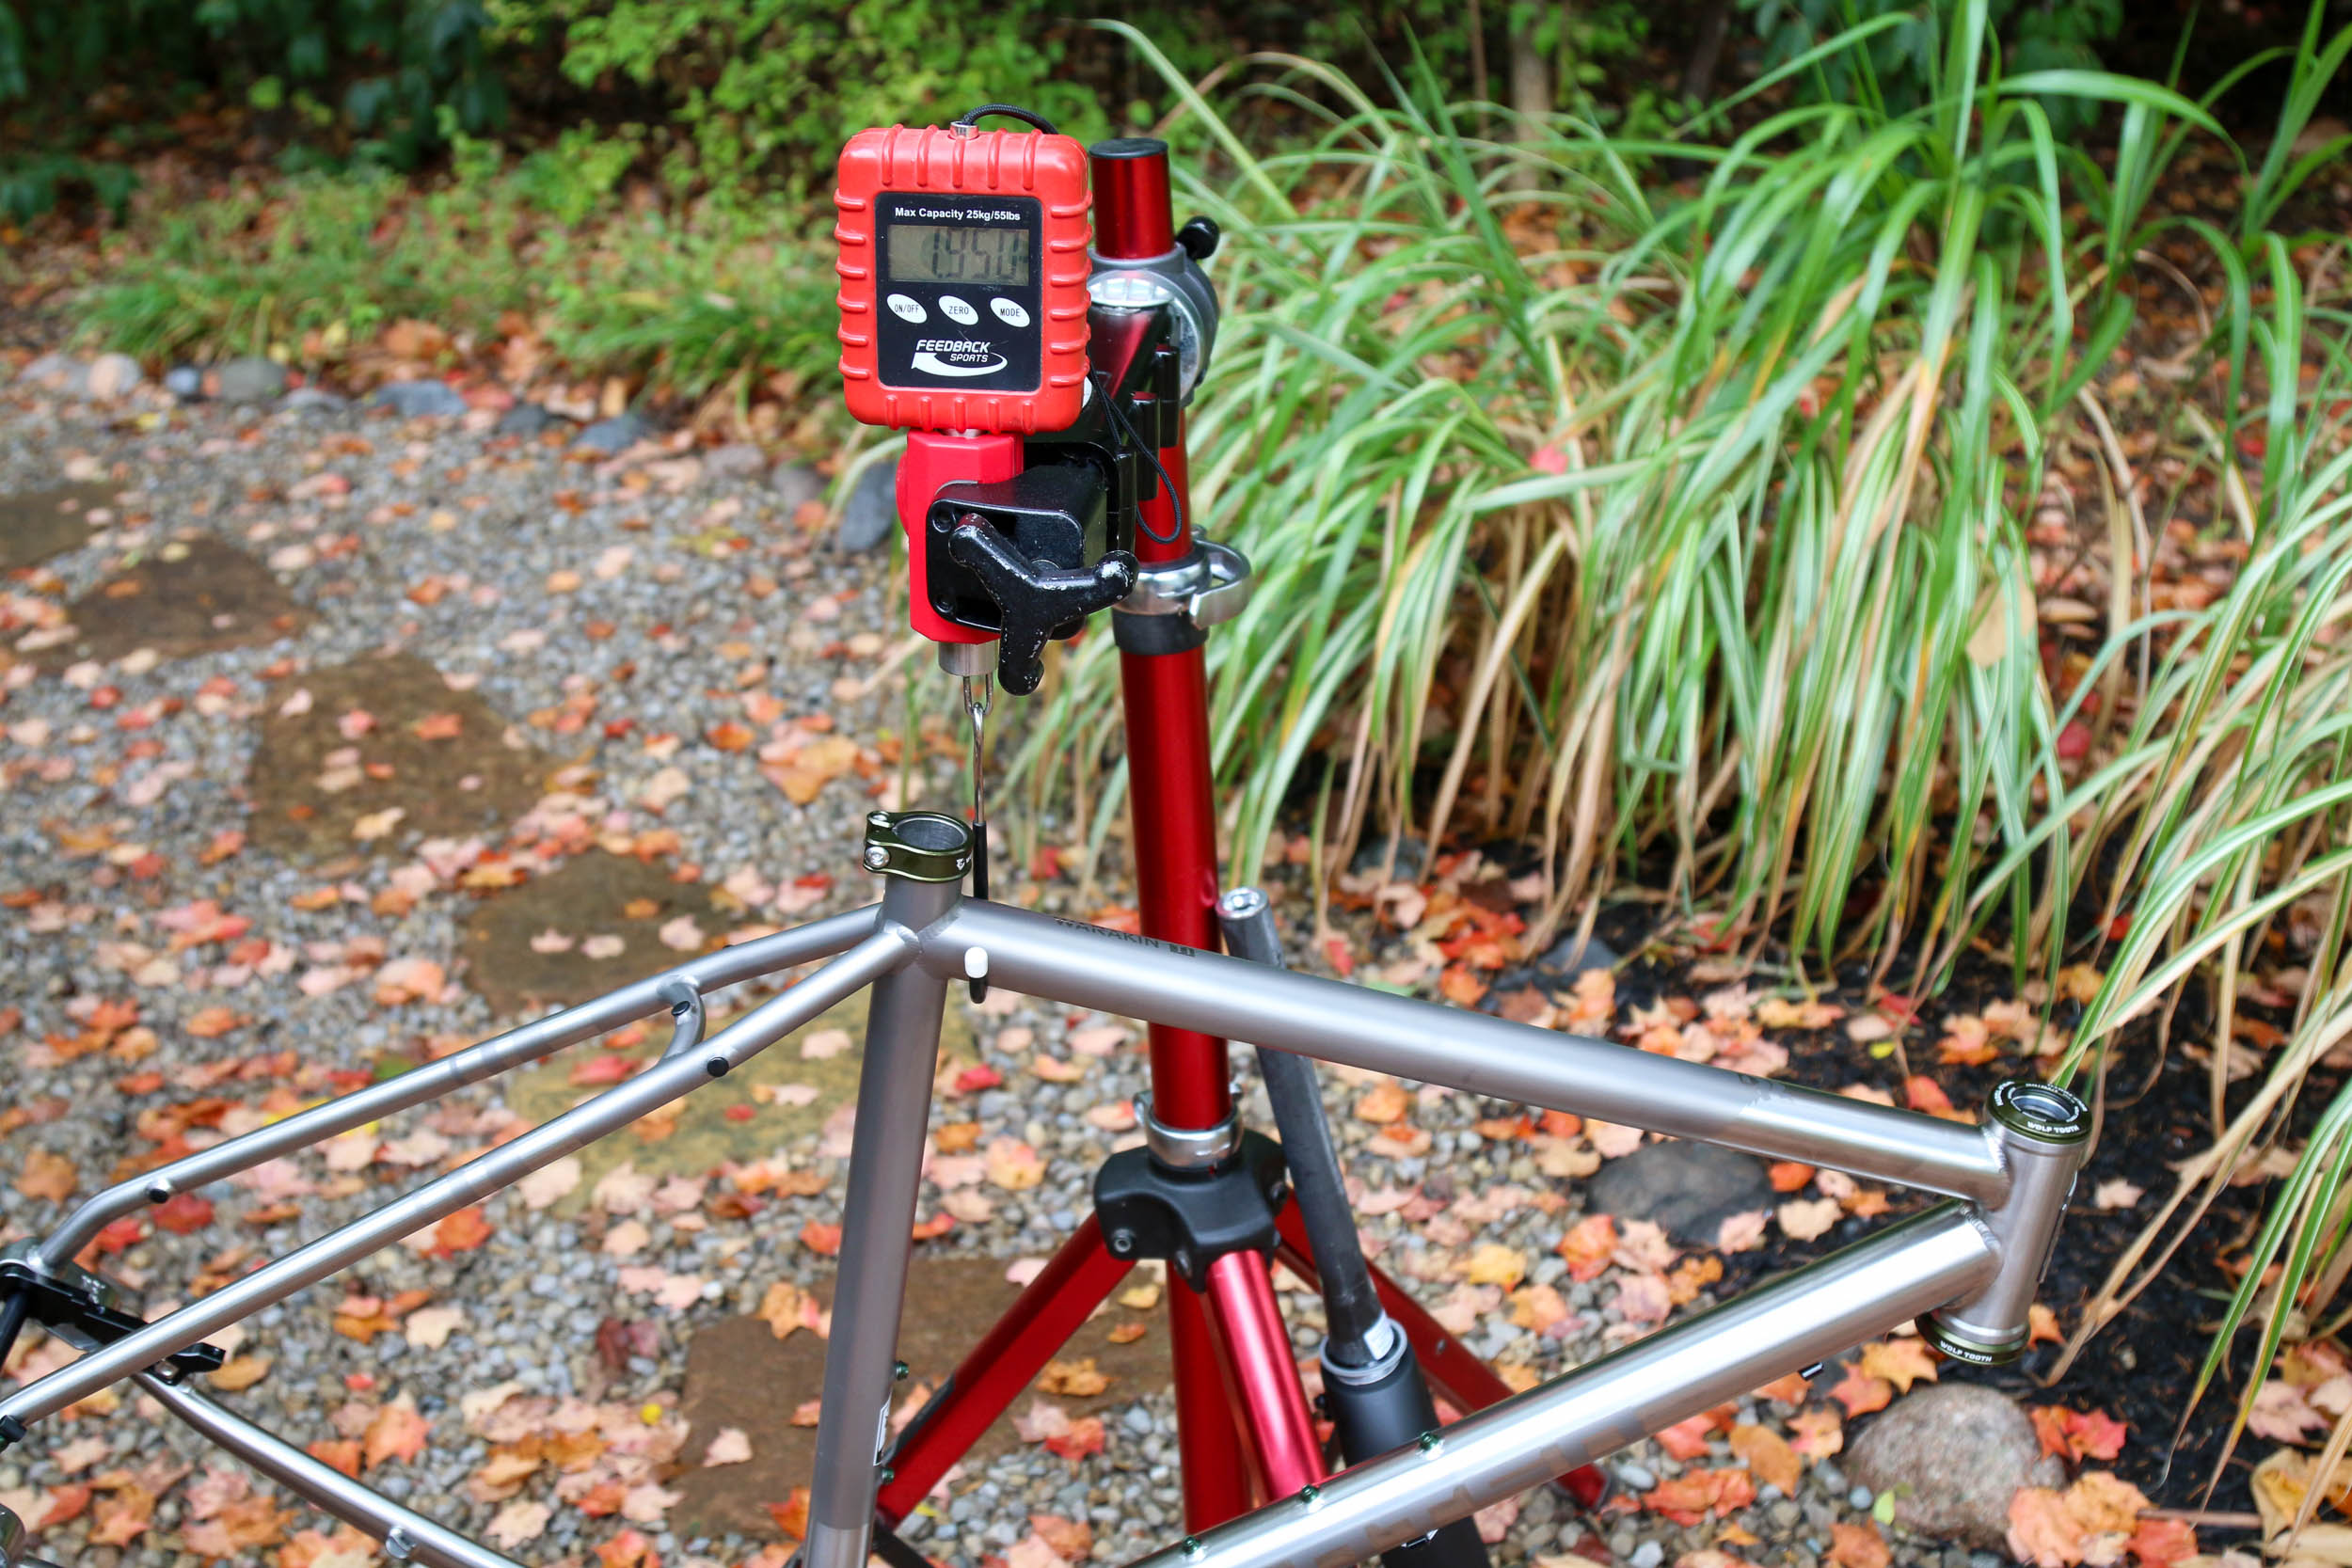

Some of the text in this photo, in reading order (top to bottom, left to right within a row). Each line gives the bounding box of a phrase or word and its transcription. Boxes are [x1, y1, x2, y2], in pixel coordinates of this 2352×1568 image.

[894, 207, 1021, 222] Max Capacity 25kg/55lbs
[894, 303, 919, 313] ON/OFF
[948, 305, 970, 315] ZERO
[999, 308, 1021, 317] MODE
[915, 339, 991, 354] FEEDBACK
[949, 353, 989, 363] SPORTS
[2027, 1121, 2079, 1133] WOLF TOOTH
[1940, 1339, 1993, 1362] WOLF TOOTH
